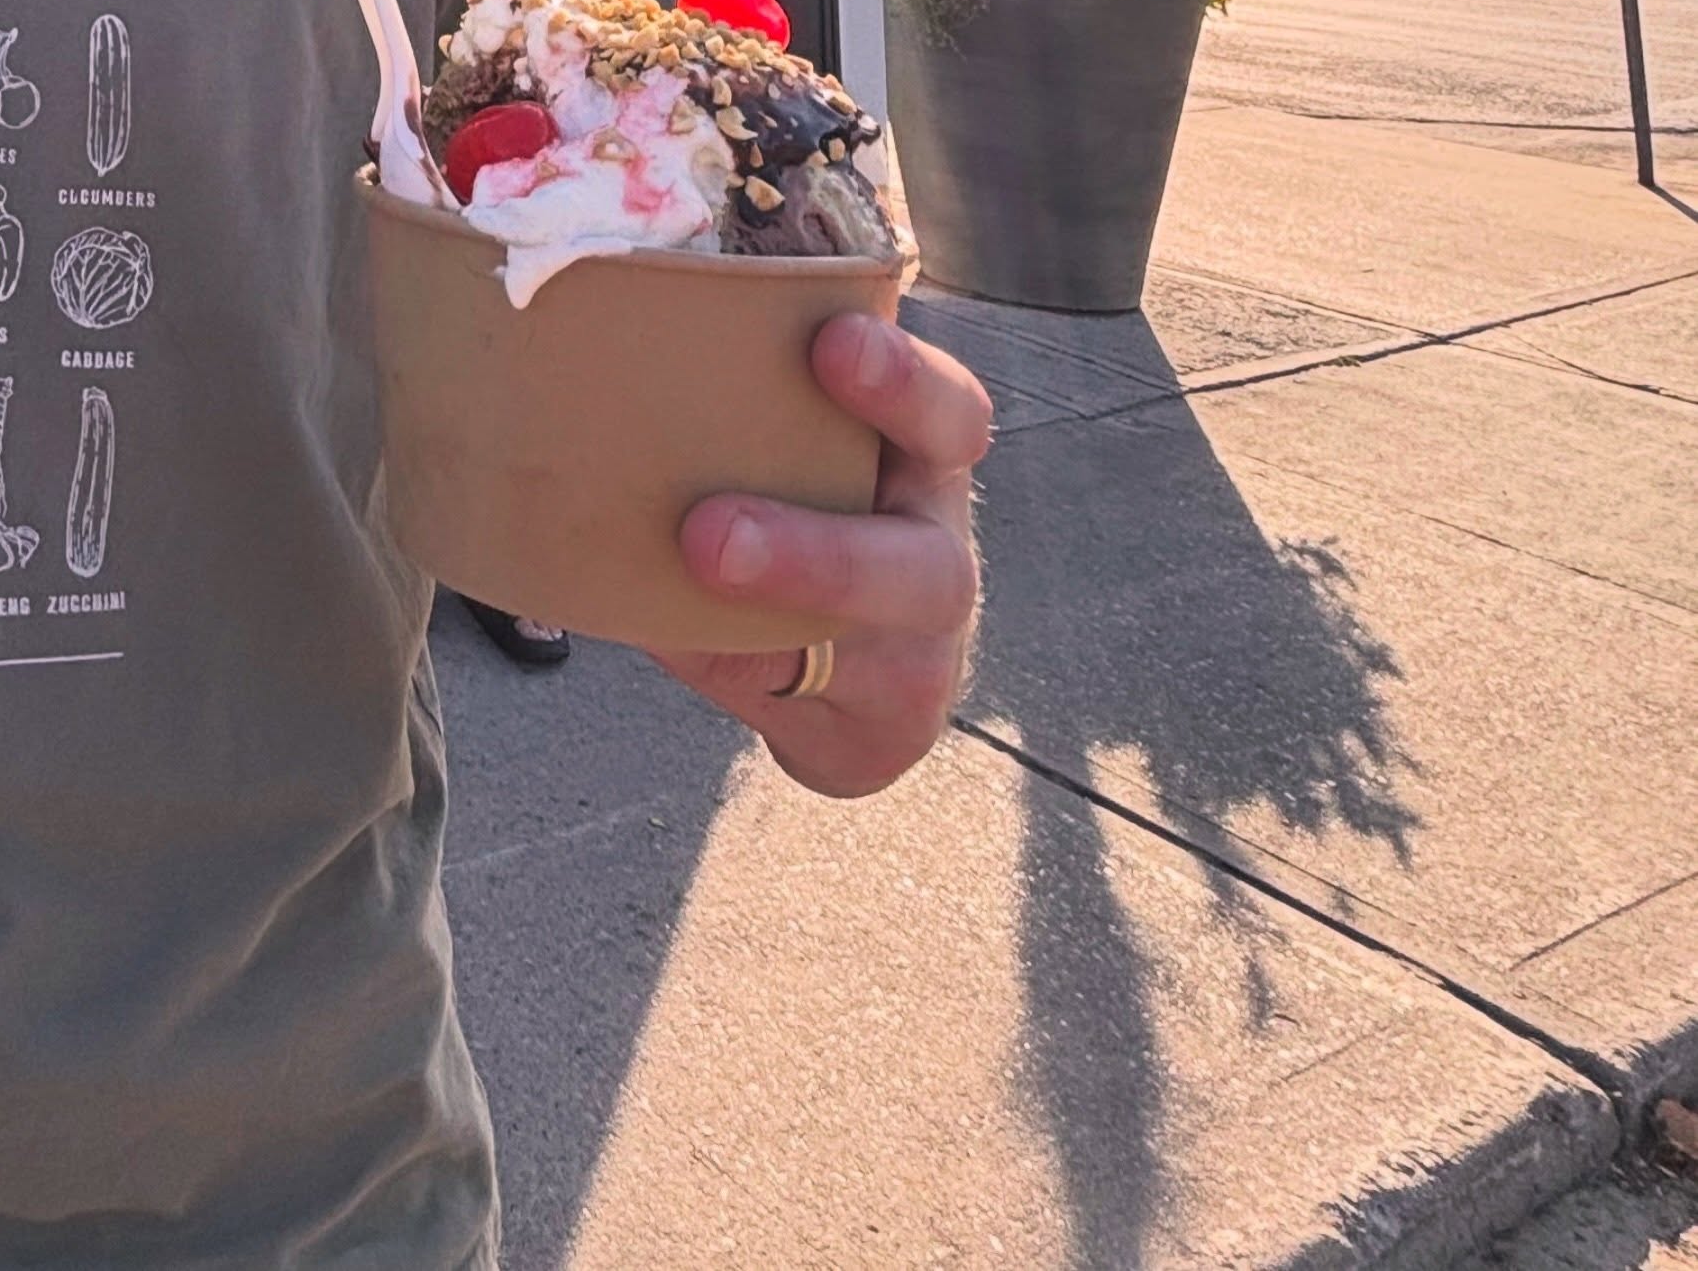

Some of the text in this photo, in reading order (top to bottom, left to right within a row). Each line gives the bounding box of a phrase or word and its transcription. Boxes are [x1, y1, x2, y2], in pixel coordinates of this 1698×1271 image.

[58, 188, 156, 208] CUCUMBERS
[61, 349, 135, 369] CABBAGE
[46, 591, 127, 615] ZUCCHINI
